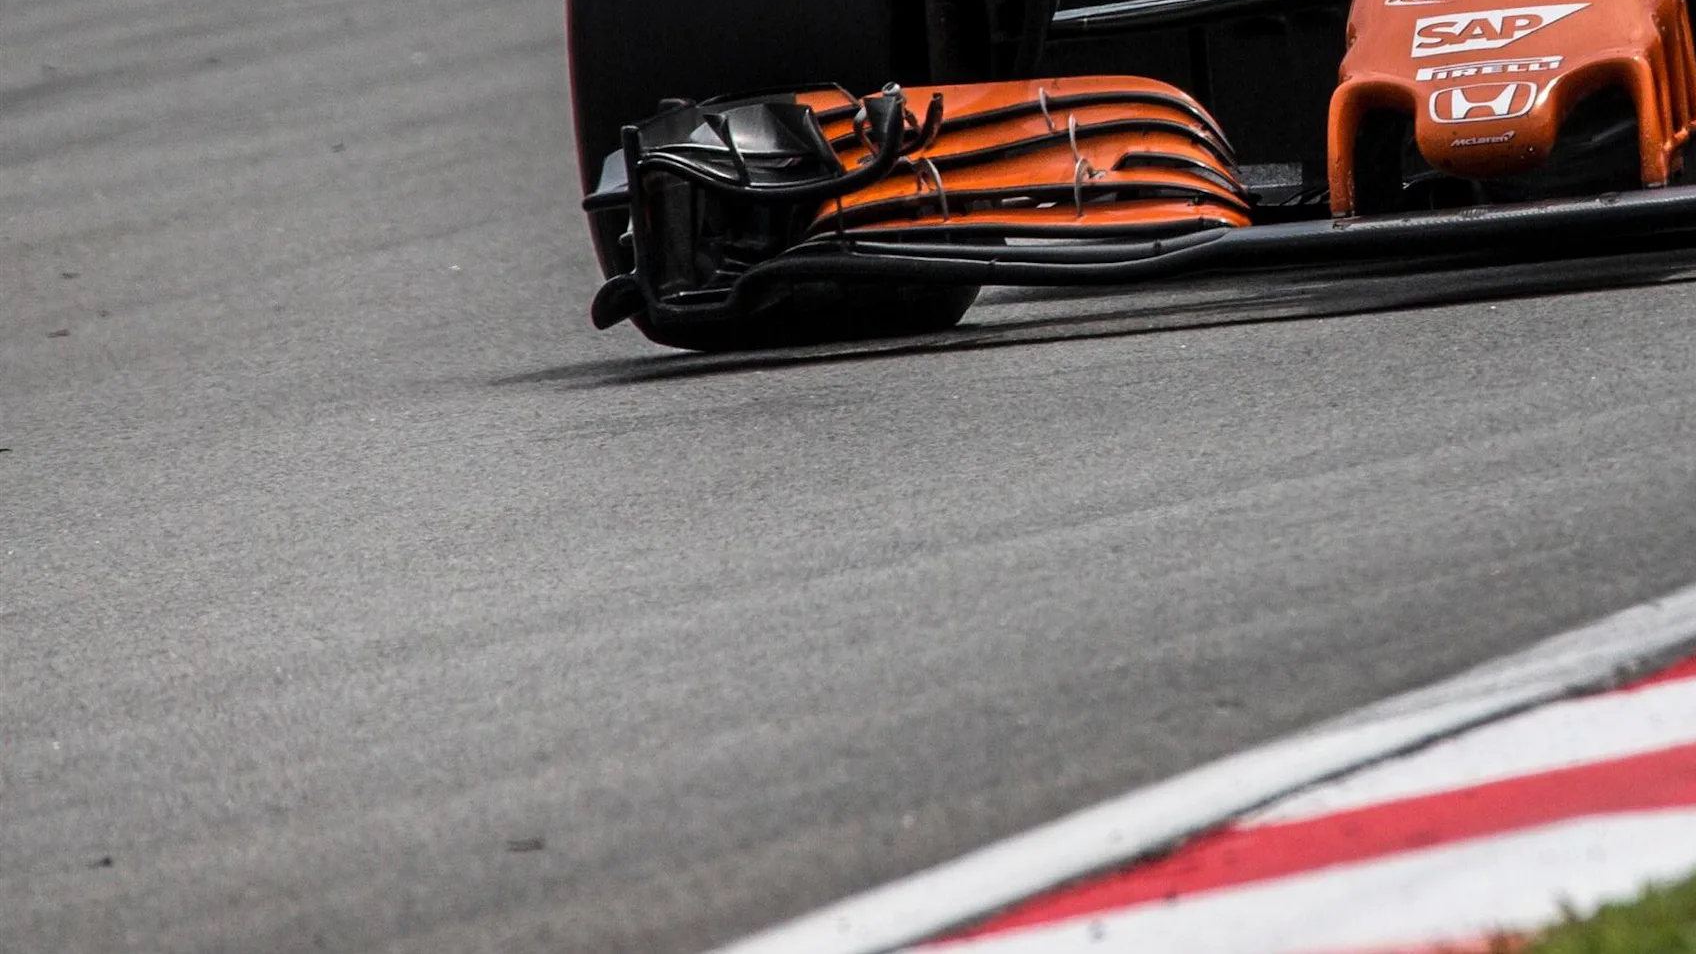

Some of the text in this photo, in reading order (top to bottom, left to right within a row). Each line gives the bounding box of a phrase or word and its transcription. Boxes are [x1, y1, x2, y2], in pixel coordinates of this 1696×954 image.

[1415, 13, 1545, 49] SAP
[1415, 55, 1565, 82] PIRELLI
[1451, 134, 1511, 147] McLaren
